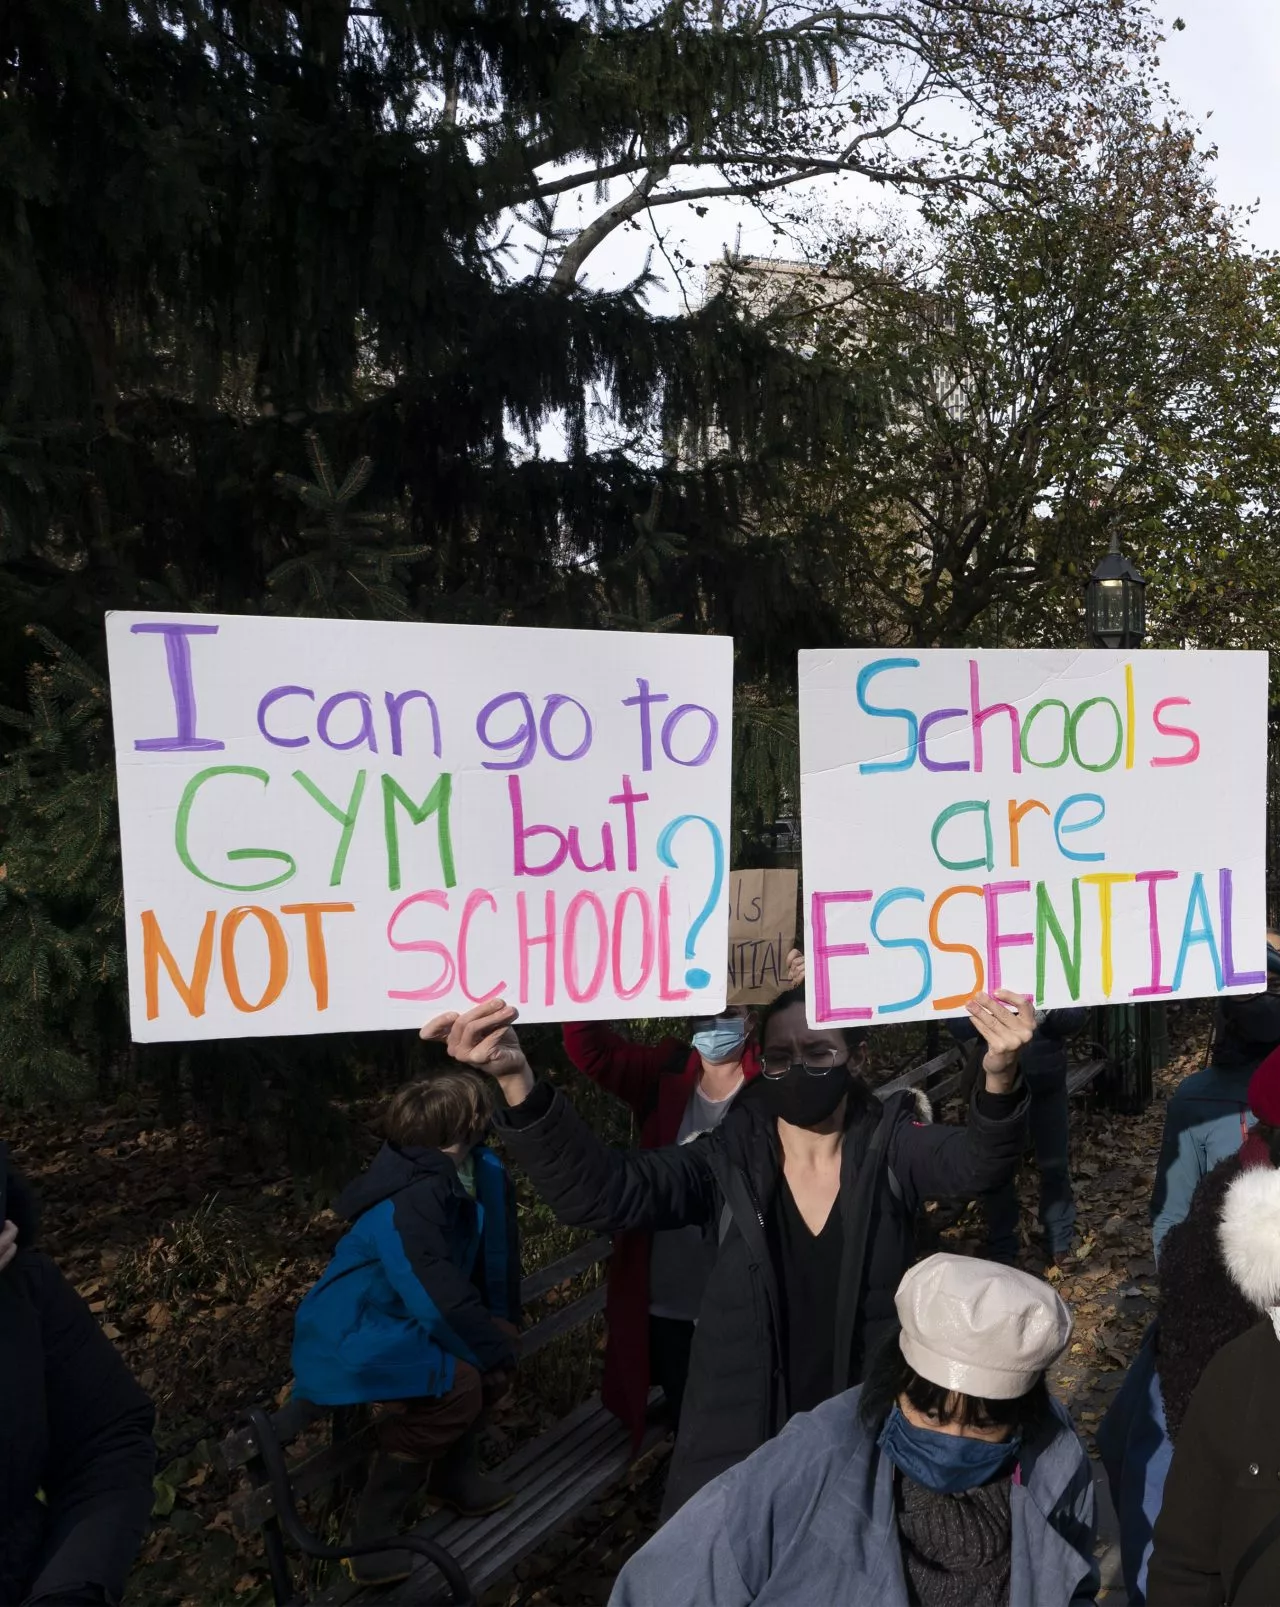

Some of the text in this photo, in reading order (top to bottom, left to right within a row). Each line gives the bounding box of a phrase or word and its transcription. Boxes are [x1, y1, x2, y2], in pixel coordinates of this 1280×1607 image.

[130, 623, 719, 771] I can go to
[856, 657, 1200, 775] Schools
[175, 765, 649, 891] GYM but
[931, 792, 1106, 872] are
[729, 878, 762, 922] ls
[810, 868, 1267, 1023] ESSENTIAL
[140, 902, 355, 1020] NOT
